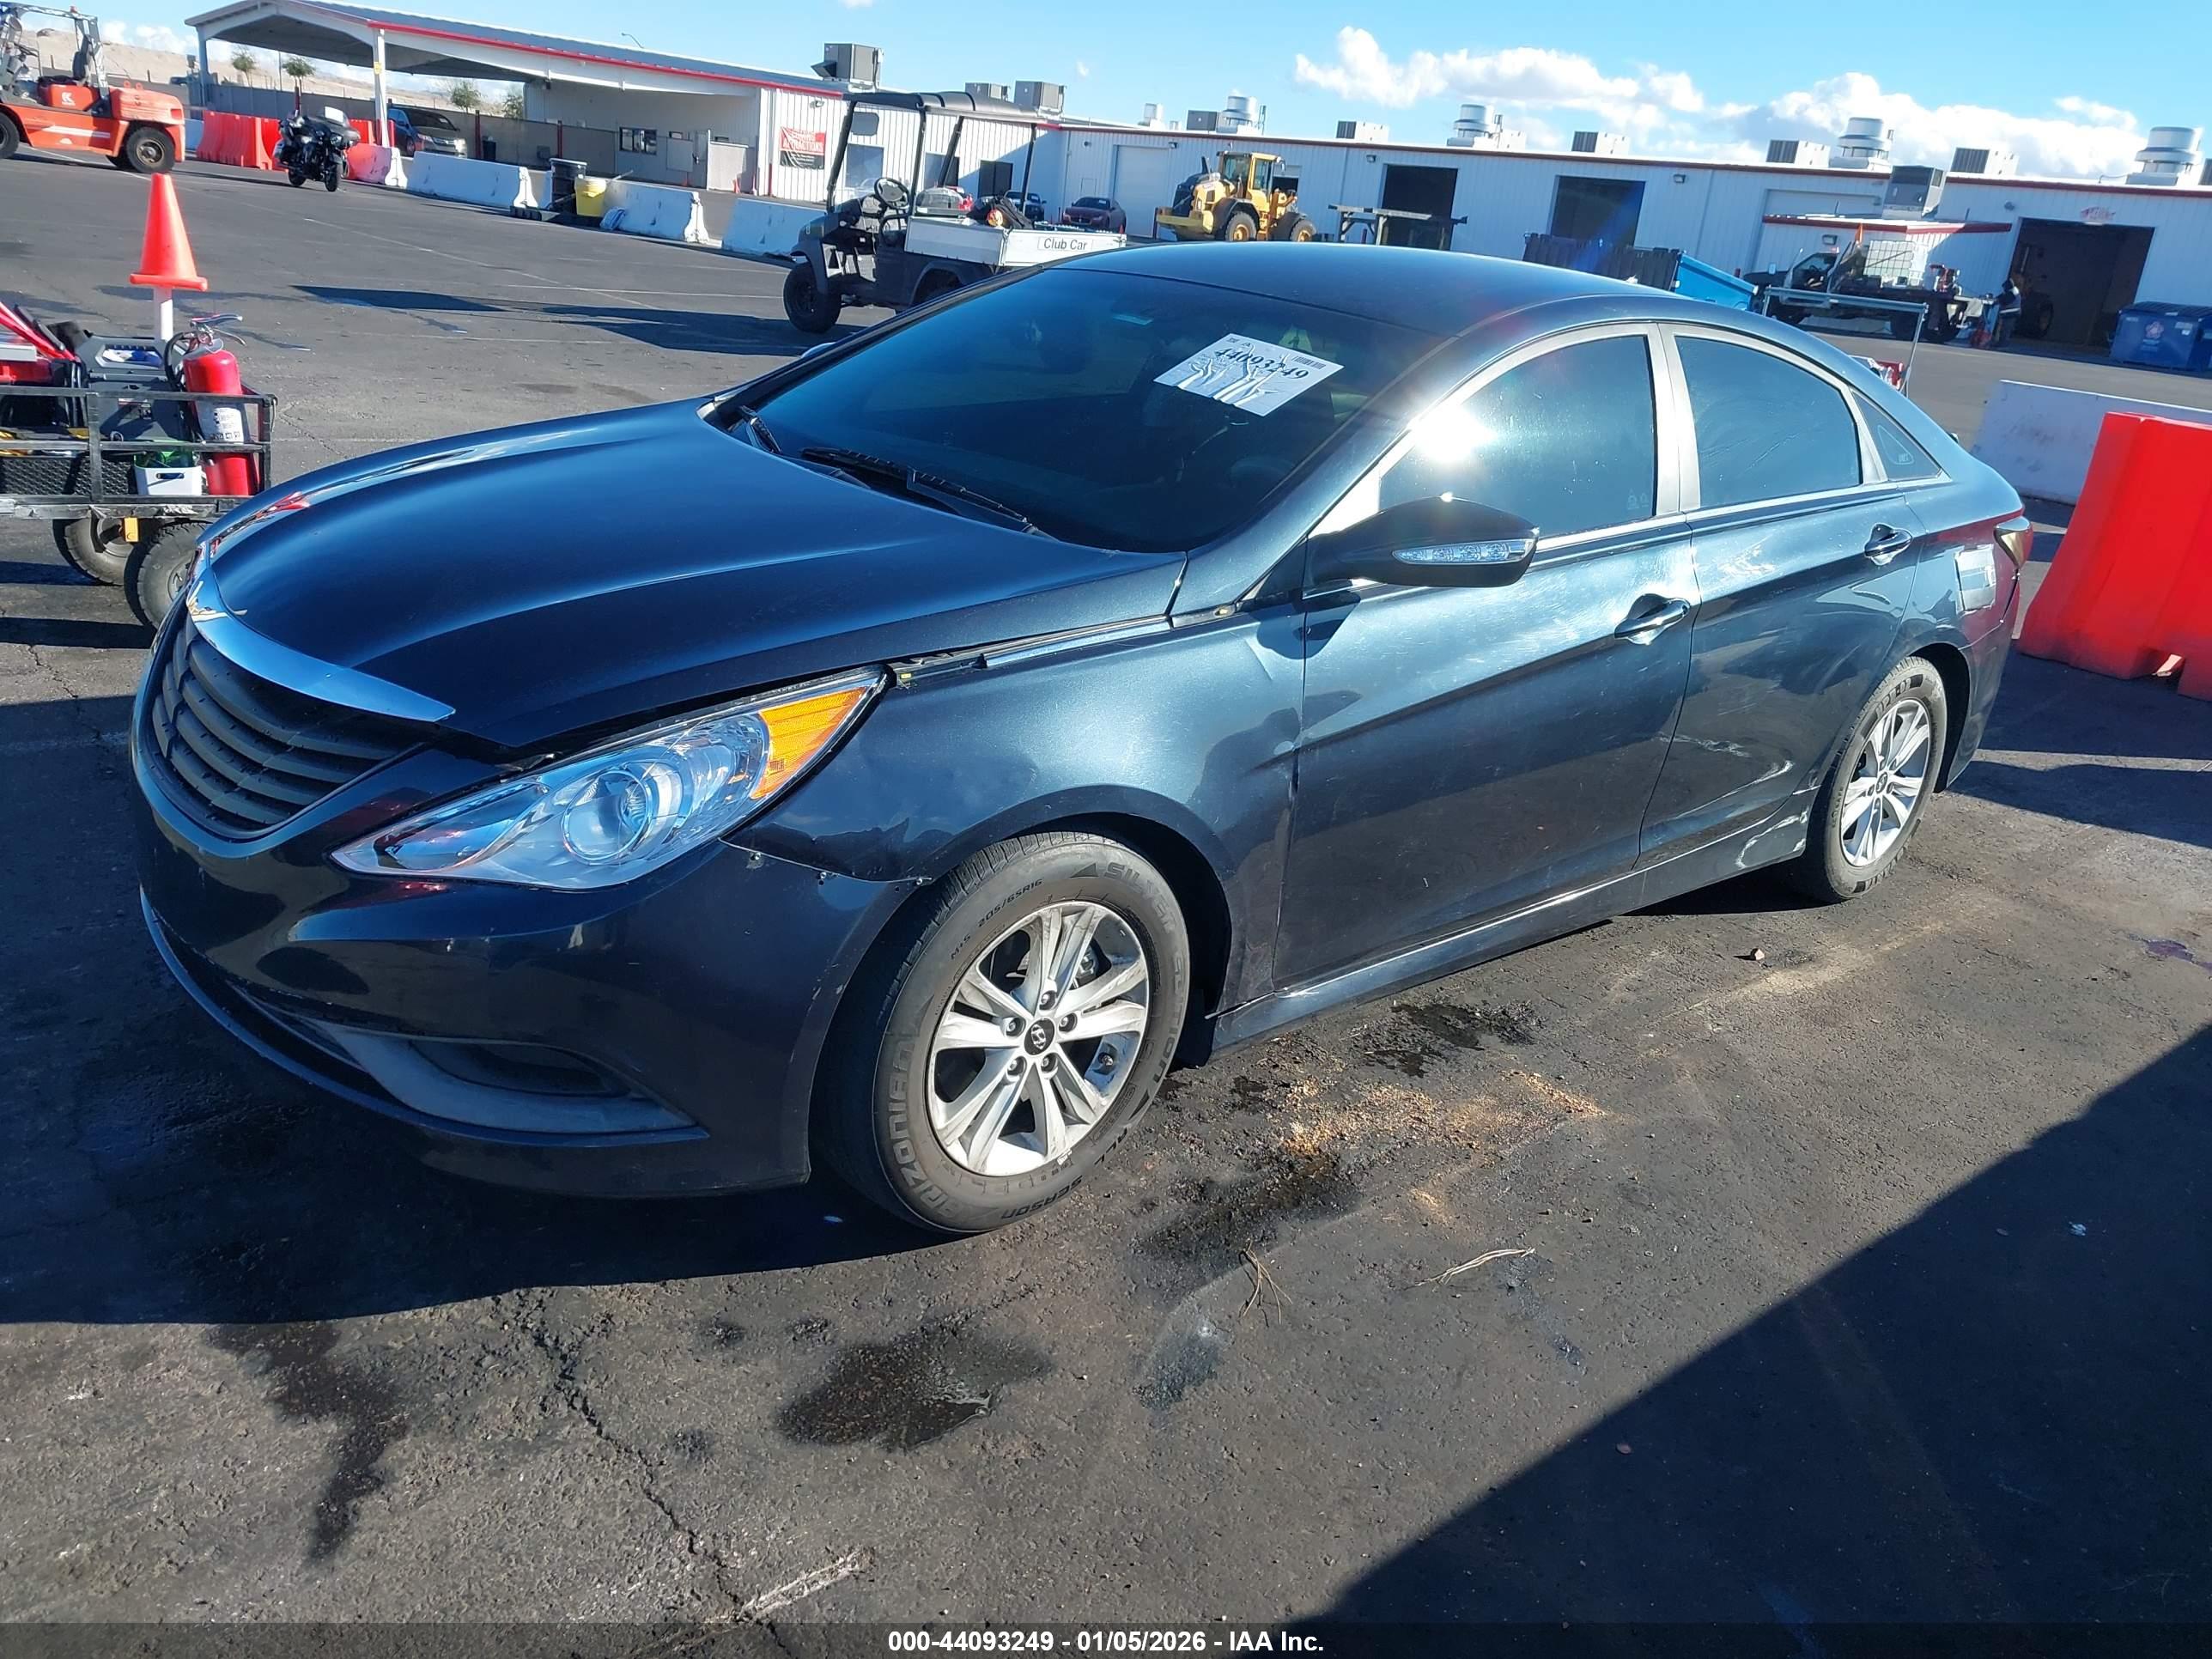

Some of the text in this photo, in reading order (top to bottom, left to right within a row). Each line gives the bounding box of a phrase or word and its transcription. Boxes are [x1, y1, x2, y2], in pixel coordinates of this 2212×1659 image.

[1043, 237, 1088, 251] Club Car
[1215, 348, 1310, 380] 44093249
[951, 878, 1043, 960] M+S 205/65R16
[1103, 861, 1176, 934] SILVER
